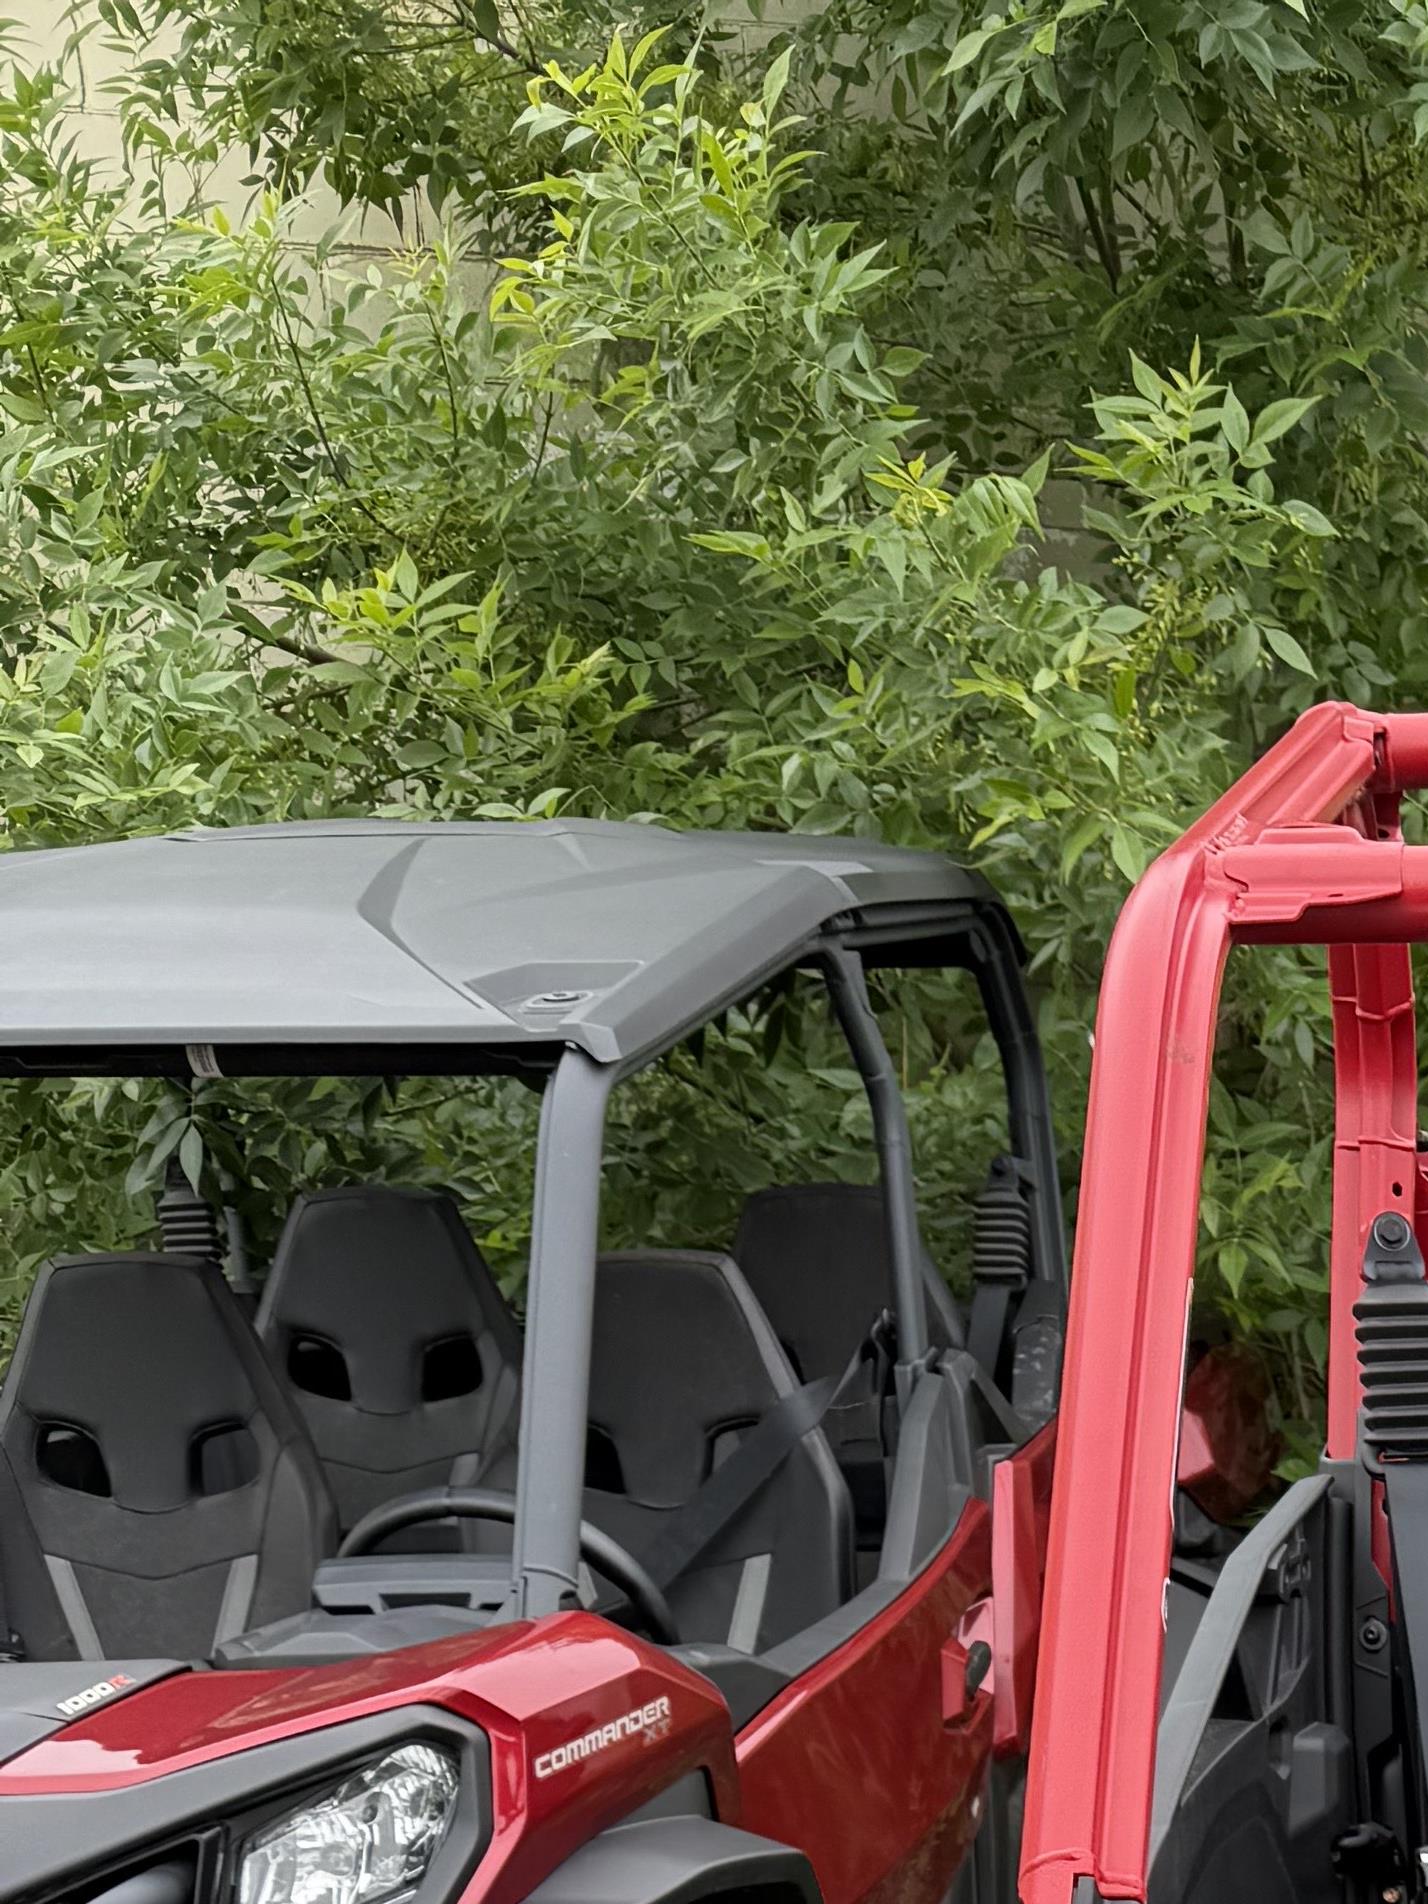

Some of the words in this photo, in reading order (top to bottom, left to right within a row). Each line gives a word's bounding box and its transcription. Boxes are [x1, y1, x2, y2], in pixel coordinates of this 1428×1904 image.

[56, 1674, 135, 1715] 1000R
[535, 1696, 671, 1778] COMMANDER
[642, 1717, 672, 1747] XT
